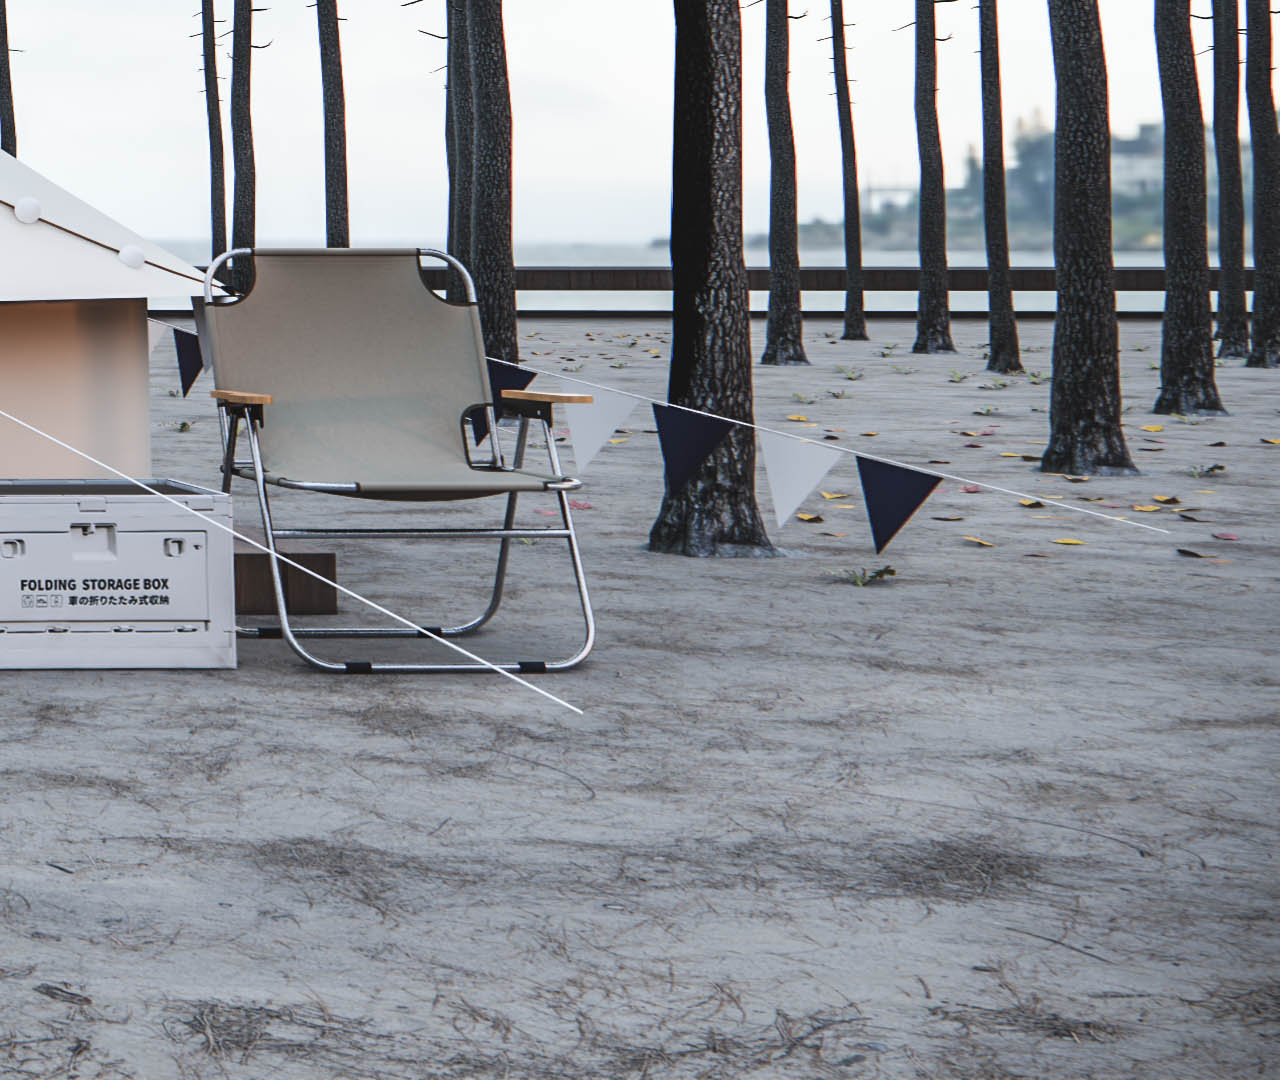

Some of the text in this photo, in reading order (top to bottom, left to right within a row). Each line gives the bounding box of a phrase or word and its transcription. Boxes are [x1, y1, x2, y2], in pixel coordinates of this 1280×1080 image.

[19, 577, 170, 591] FOLDING STORAGE BOX
